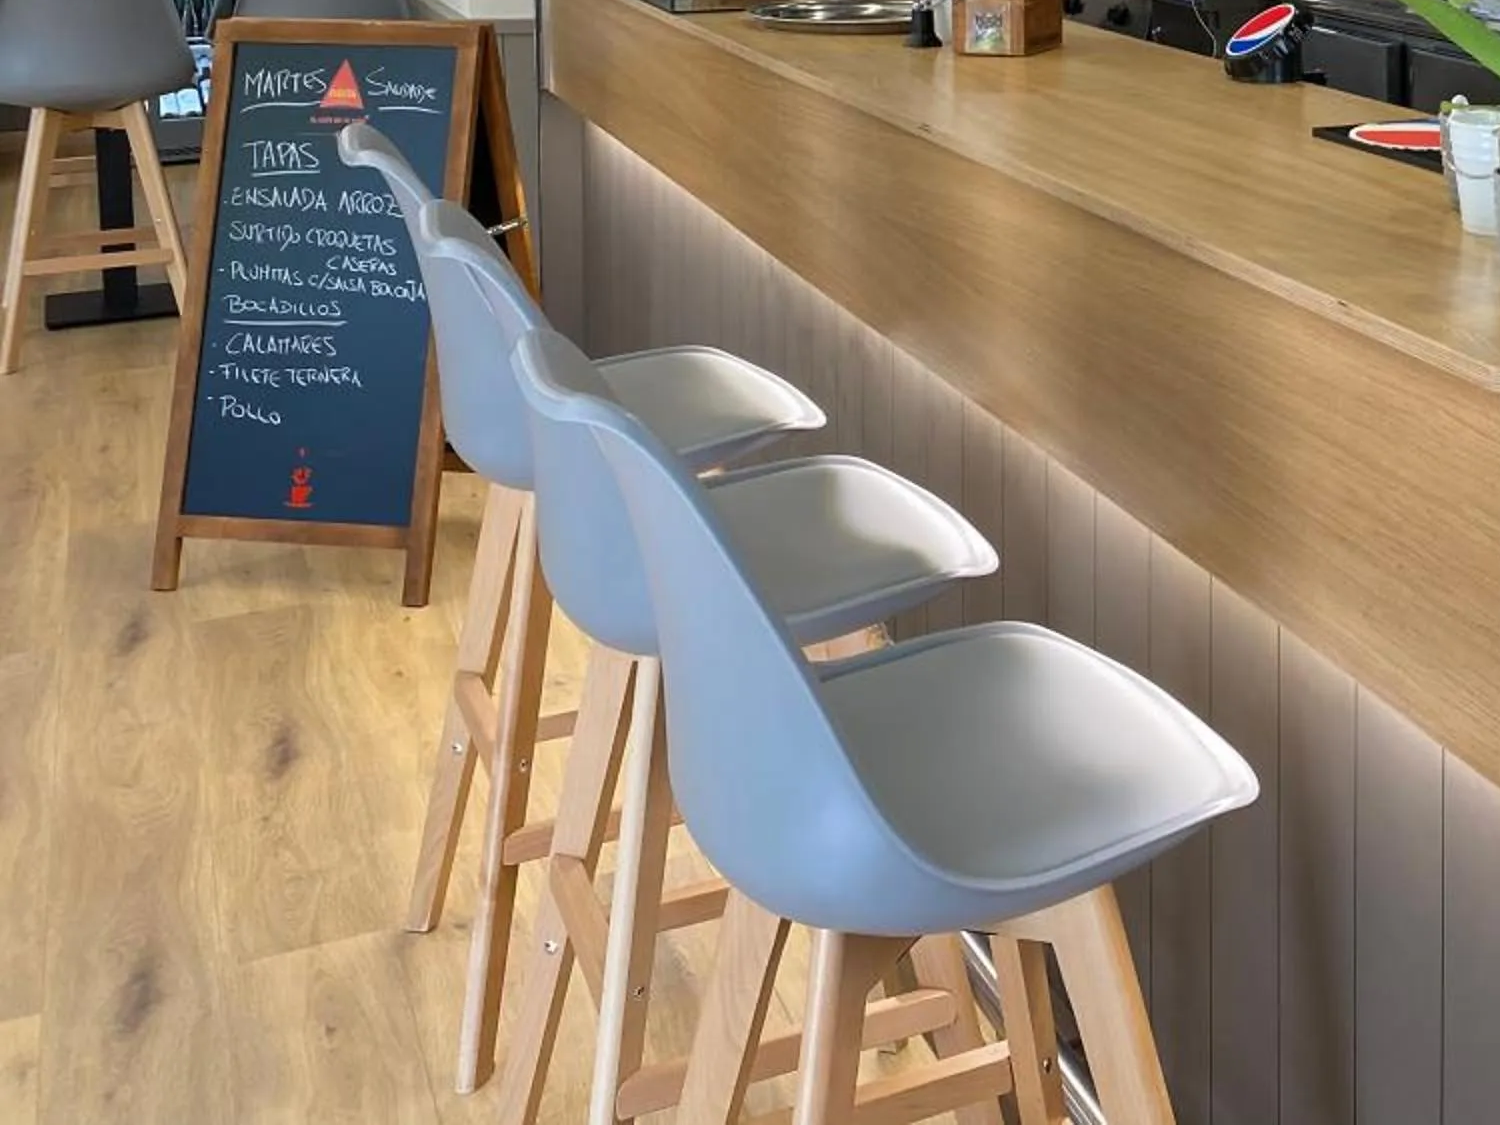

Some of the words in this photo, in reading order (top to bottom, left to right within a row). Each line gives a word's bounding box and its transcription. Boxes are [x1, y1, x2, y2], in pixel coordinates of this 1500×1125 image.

[244, 68, 328, 99] MARTES
[242, 140, 320, 170] TAPAS
[231, 187, 328, 213] ENSALADA
[338, 190, 405, 218] ARROZ
[228, 220, 301, 252] SURTIDO
[305, 227, 398, 256] CROQUETAS
[326, 255, 397, 276] CASERAS
[224, 294, 342, 317] BOCADILLOS
[225, 332, 337, 357] CALAMARES
[218, 362, 280, 388] FILETE
[285, 366, 363, 388] TERNERA
[219, 394, 282, 426] POLLO
